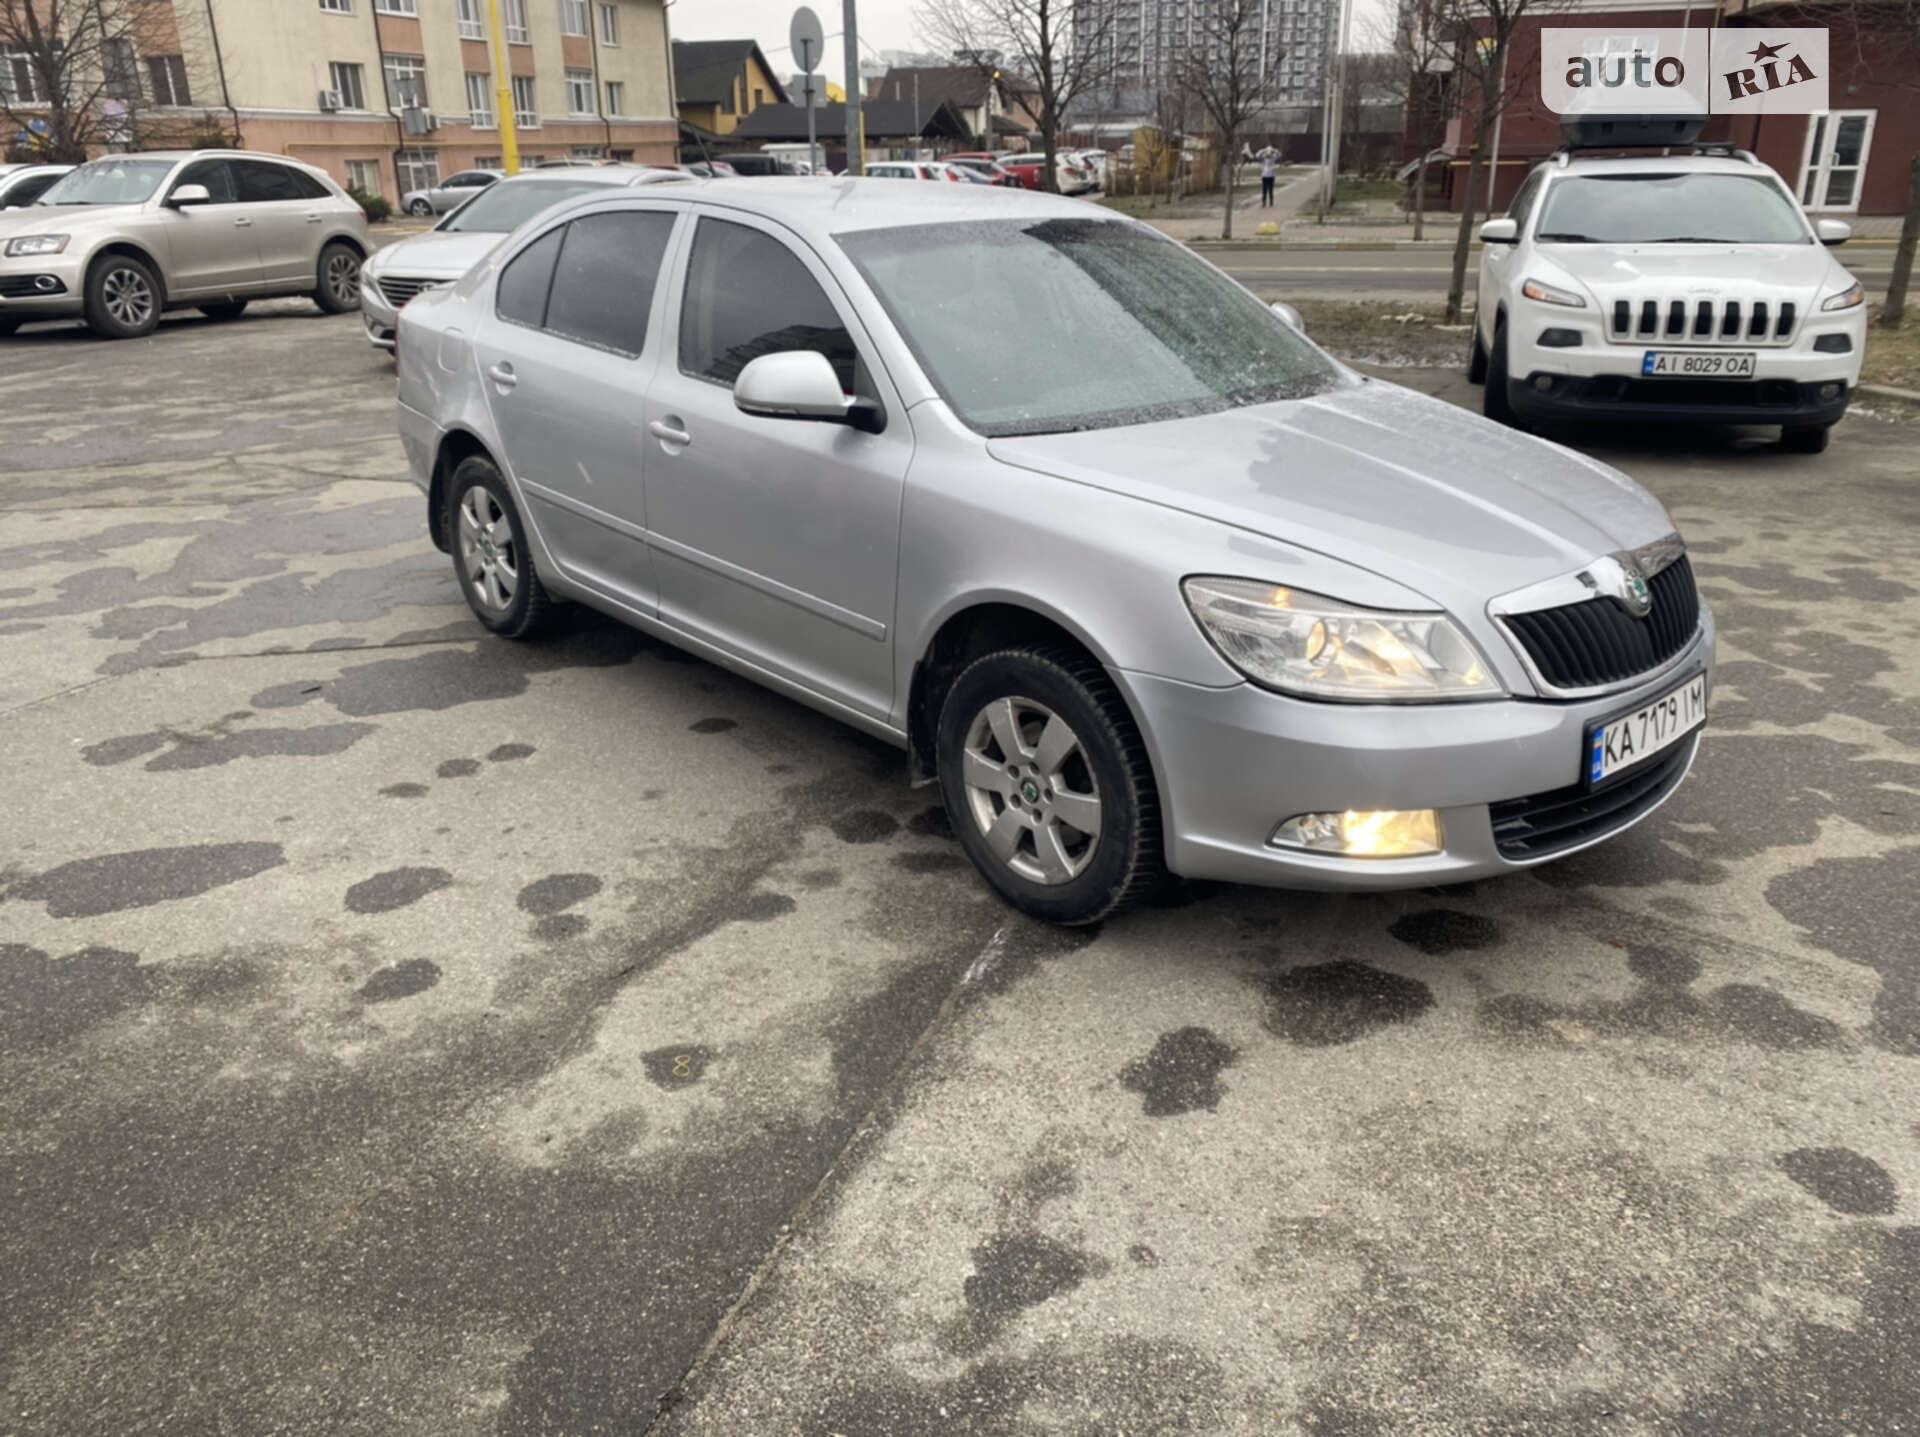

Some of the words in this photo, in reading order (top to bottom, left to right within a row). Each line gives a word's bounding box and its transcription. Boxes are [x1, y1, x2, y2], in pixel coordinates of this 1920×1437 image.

[1655, 356, 1677, 372] AI
[1683, 357, 1722, 373] 8029
[1726, 358, 1750, 373] OA
[1603, 721, 1634, 768] KA
[1637, 696, 1678, 749] 7179
[1683, 681, 1703, 723] IM
